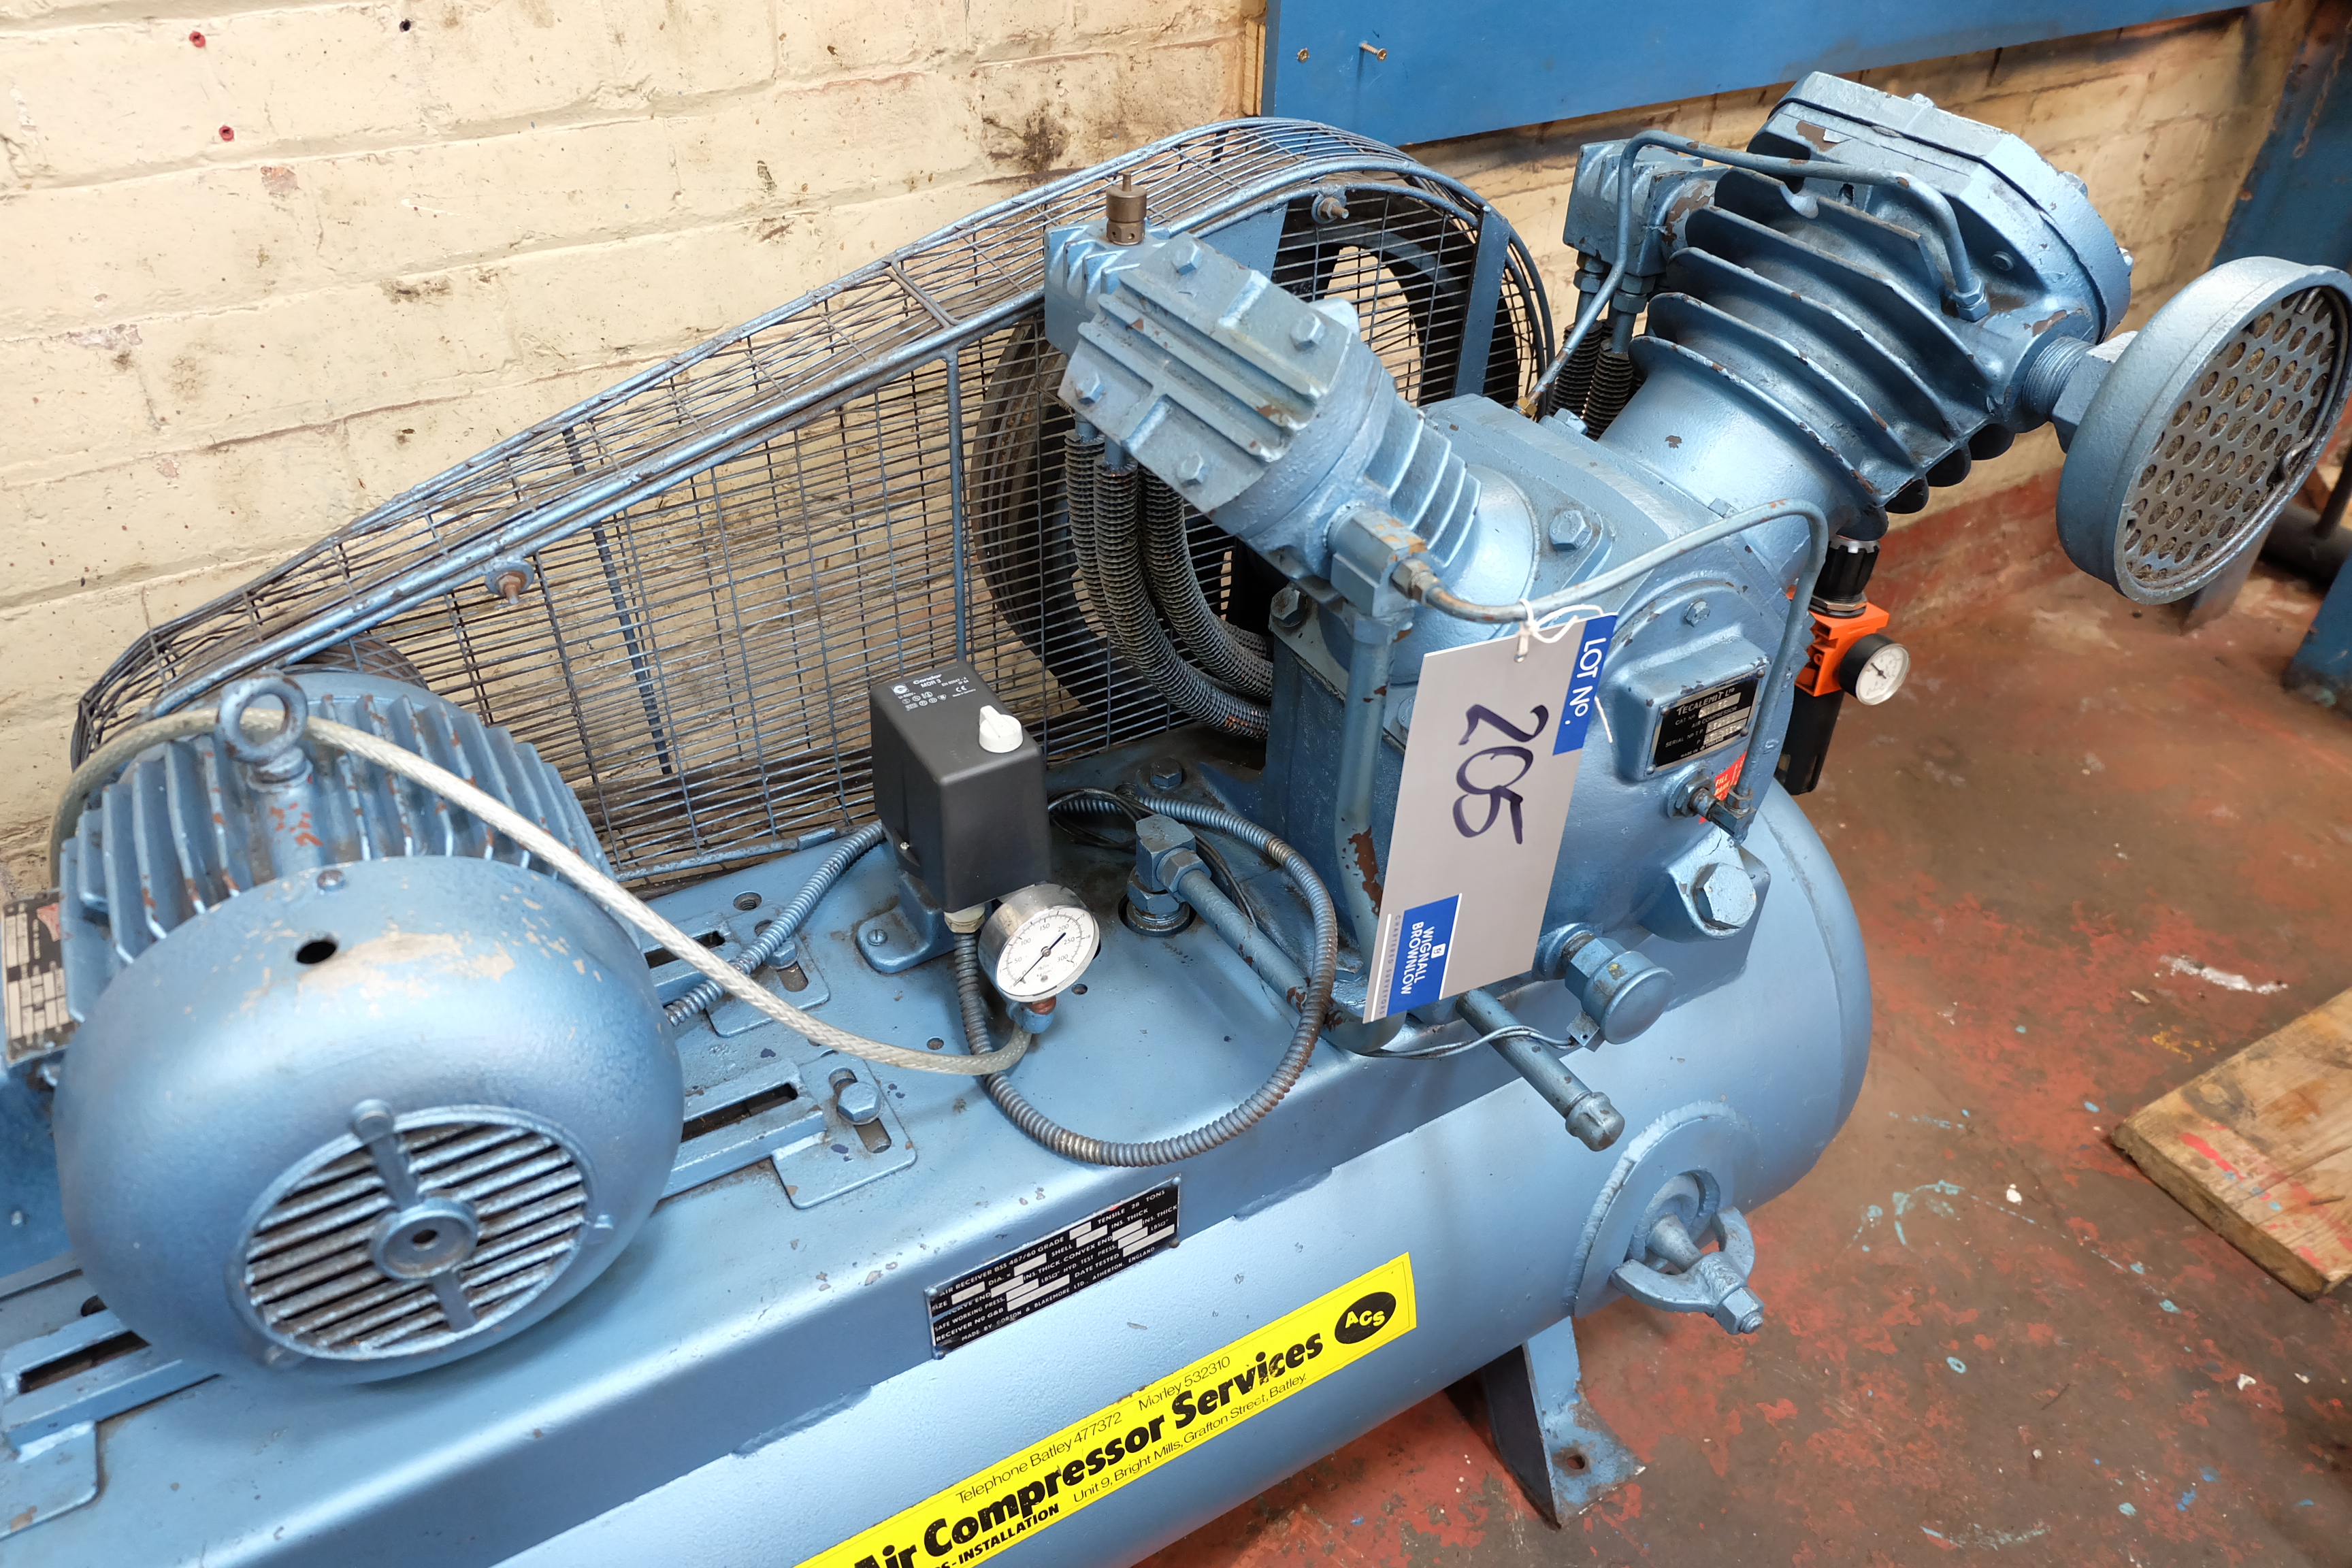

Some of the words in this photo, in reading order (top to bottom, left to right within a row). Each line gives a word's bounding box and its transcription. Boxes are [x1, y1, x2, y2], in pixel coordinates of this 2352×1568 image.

[913, 674, 942, 685] Condor
[1578, 637, 1607, 678] LOT
[920, 680, 936, 688] MDR
[1564, 685, 1594, 725] No.
[1676, 691, 1724, 716] TECALEMIT
[1691, 721, 1701, 729] AIR
[1701, 706, 1737, 724] COMPRESSOR
[1665, 737, 1684, 748] SERIAL
[1452, 703, 1550, 845] 205
[1021, 937, 1031, 946] 100
[1040, 923, 1050, 931] 150
[1058, 924, 1069, 932] 200
[1064, 936, 1075, 945] 250
[1388, 915, 1401, 964] CHARTERED
[1014, 956, 1022, 964] 50
[1057, 953, 1068, 962] 300
[1401, 921, 1424, 994] BROWNLOW
[1414, 926, 1435, 983] WIGNALL
[1379, 969, 1392, 1015] SURVEYORS
[932, 1301, 948, 1311] SIZE
[988, 1277, 1004, 1286] DIA.
[1051, 1243, 1073, 1258] SHELL
[1111, 1218, 1125, 1229] INS.
[1126, 1208, 1149, 1222] THICK
[940, 1288, 953, 1296] AIR
[956, 1269, 992, 1290] RECEIVER
[994, 1262, 1007, 1273] BSS
[1009, 1250, 1036, 1265] 487/60
[1037, 1236, 1064, 1252] GRADE
[1097, 1208, 1125, 1224] TENSILE
[1145, 1190, 1165, 1202] TONS
[975, 1292, 991, 1303] END
[1063, 1243, 1096, 1262] CONVEX
[1098, 1235, 1113, 1247] END
[1142, 1215, 1156, 1225] INS.
[1156, 1204, 1177, 1218] THICK
[934, 1320, 951, 1332] SAFE
[952, 1307, 983, 1324] WORKING
[985, 1296, 1005, 1309] PRESS.
[1081, 1254, 1094, 1264] TEST
[1097, 1244, 1117, 1257] PRESS.
[936, 1322, 973, 1342] RECEIVER
[987, 1307, 1004, 1319] G&B
[1074, 1265, 1093, 1278] DATE
[1095, 1253, 1120, 1268] TESTED
[962, 1330, 980, 1341] MADE
[983, 1323, 993, 1332] BY
[1034, 1287, 1070, 1308] BLAKEMORE
[1128, 1246, 1155, 1263] ENGLAND
[1345, 1310, 1386, 1329] ACS
[924, 1414, 1165, 1557] Compressor
[1171, 1333, 1324, 1429] Services
[956, 1460, 1028, 1503] Telephone
[1030, 1438, 1073, 1467] Batley
[1073, 1411, 1122, 1443] 477372
[1138, 1382, 1182, 1411] Morley
[1183, 1356, 1230, 1388] 532310
[1073, 1484, 1100, 1503] Unit
[1100, 1477, 1114, 1492] 9,
[1114, 1454, 1152, 1481] Bright
[1154, 1437, 1184, 1461] Mills,
[1183, 1414, 1228, 1443] Grafton
[1230, 1394, 1270, 1419] Street,
[1269, 1373, 1307, 1399] Batley.
[958, 1503, 1060, 1566] INSTALLATION
